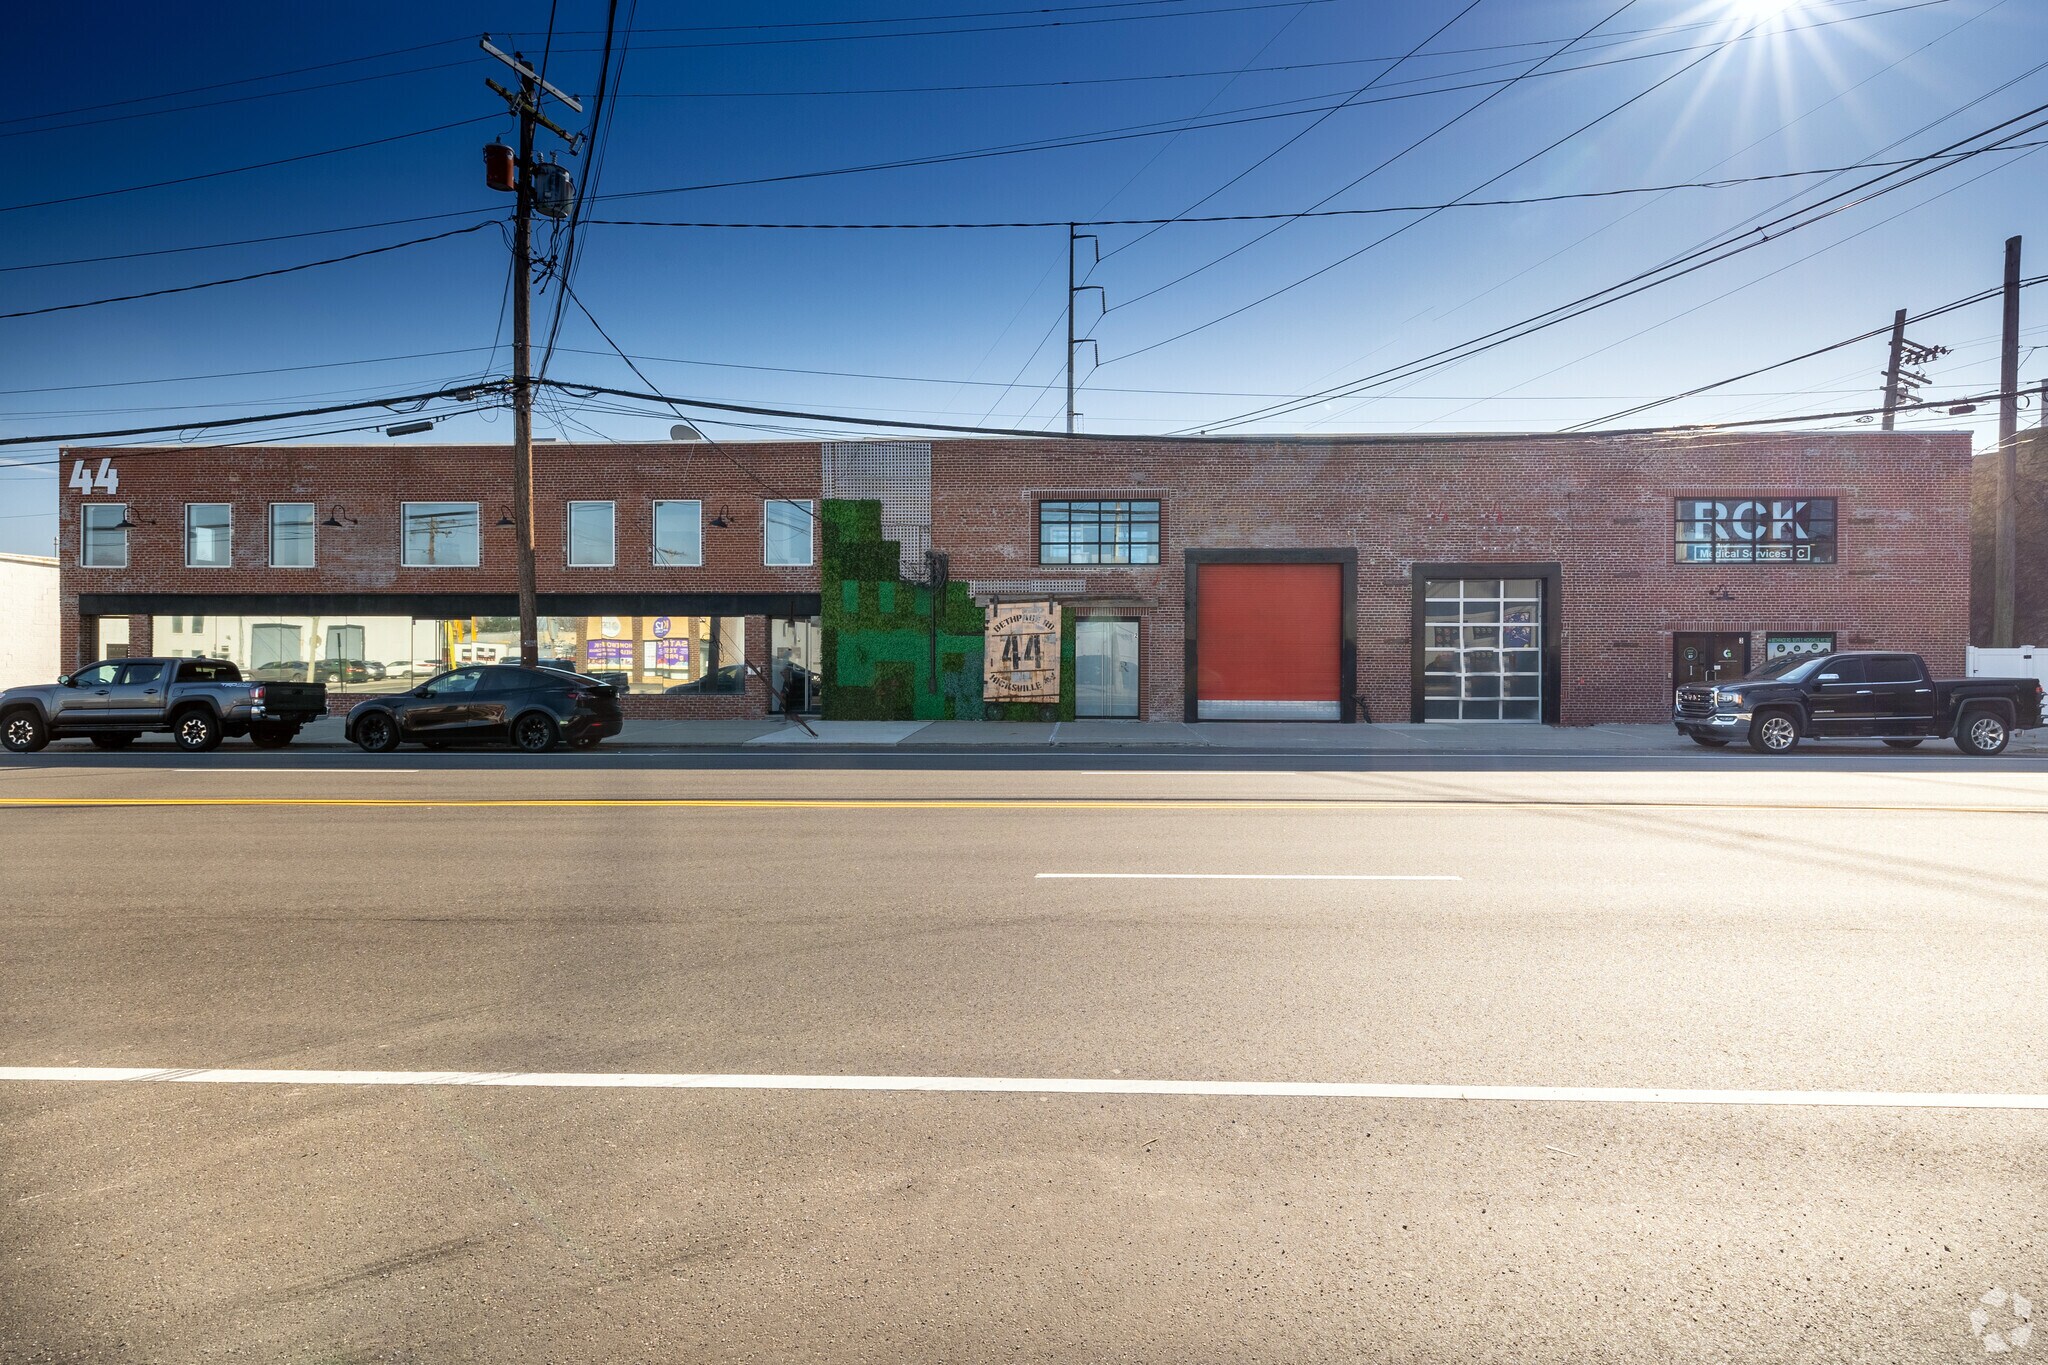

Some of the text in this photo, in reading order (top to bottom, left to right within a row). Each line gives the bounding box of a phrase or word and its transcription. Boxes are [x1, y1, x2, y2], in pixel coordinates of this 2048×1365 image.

[69, 458, 119, 495] 44
[1695, 501, 1808, 540] RCK
[1700, 549, 1739, 558] Medical
[993, 614, 1055, 633] BETHPAGE RD
[1002, 634, 1042, 669] 44
[989, 674, 1042, 692] HICKSVILLE
